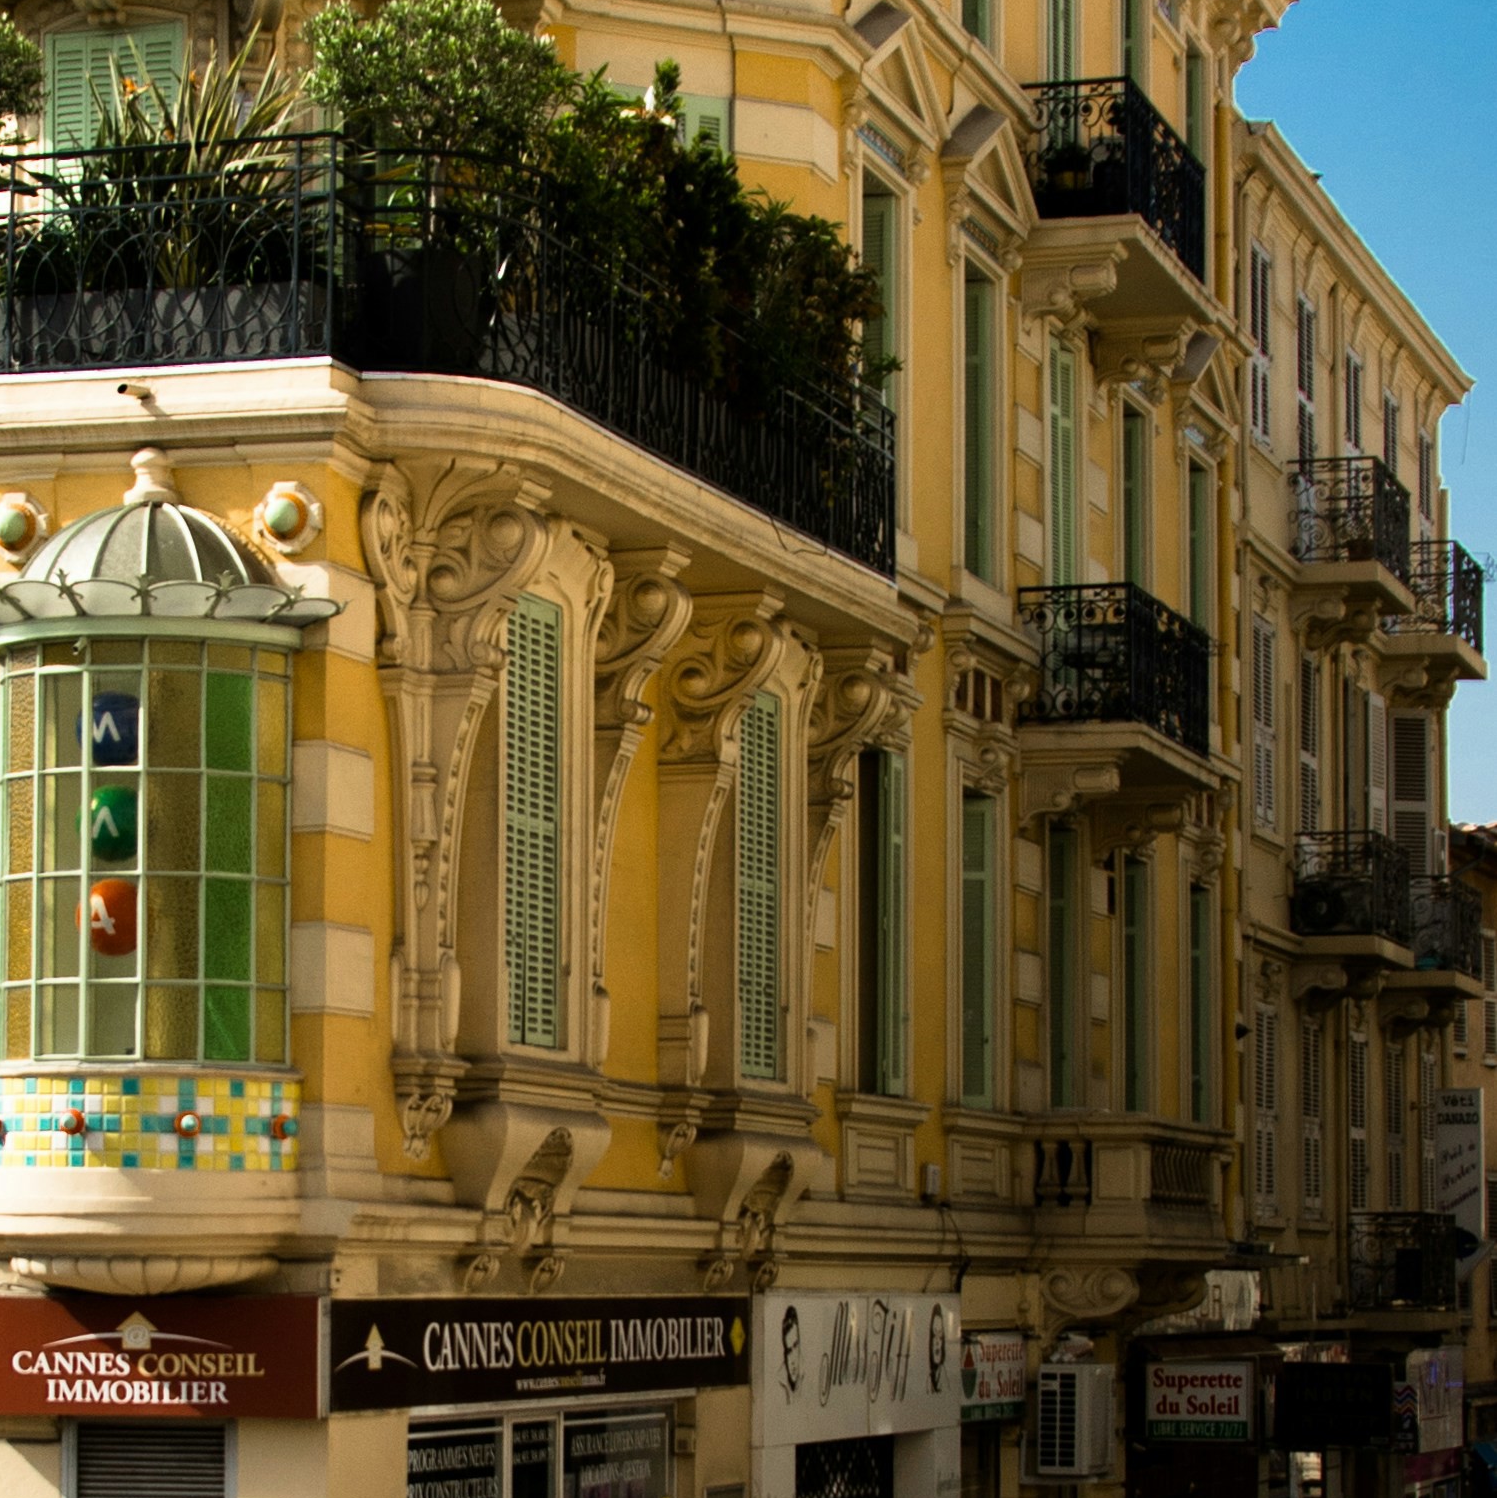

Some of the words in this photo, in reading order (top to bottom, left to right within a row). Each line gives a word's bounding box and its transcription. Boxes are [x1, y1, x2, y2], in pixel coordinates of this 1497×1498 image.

[1437, 1112, 1479, 1125] DANAZO
[423, 1321, 514, 1372] CANNES
[516, 1319, 607, 1367] CONSEIL
[609, 1316, 725, 1363] IMMOBILIER
[12, 1350, 130, 1376] CANNES
[137, 1353, 265, 1378] CONSEIL
[46, 1378, 229, 1404] IMMOBILIER
[979, 1370, 991, 1400] du
[997, 1366, 1024, 1399] Soleil
[1153, 1367, 1243, 1394] Superette
[1156, 1394, 1180, 1415] du
[1186, 1394, 1240, 1415] Soleil
[1153, 1421, 1177, 1437] LIBRE
[1180, 1421, 1216, 1437] SERVICE
[408, 1446, 468, 1472] PROGRAMMES
[469, 1443, 496, 1466] NEUFS
